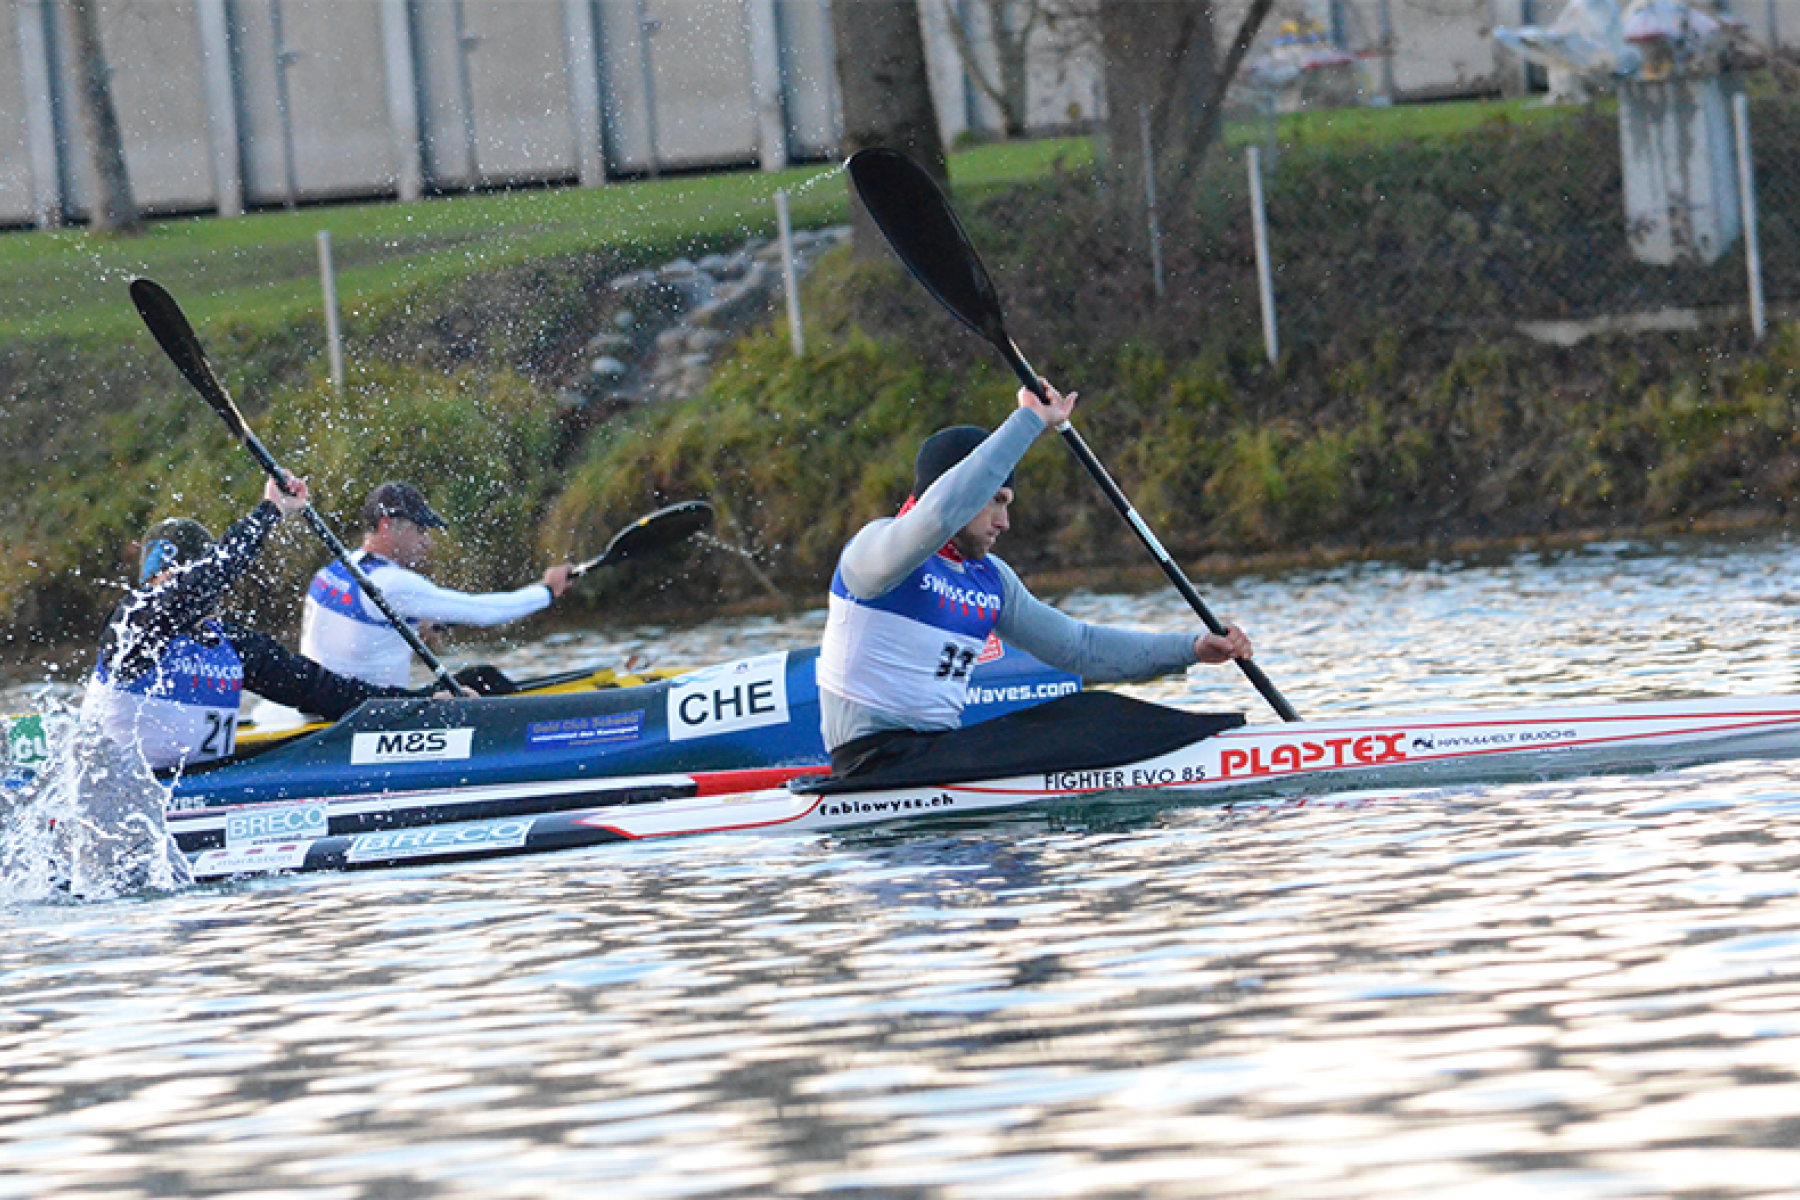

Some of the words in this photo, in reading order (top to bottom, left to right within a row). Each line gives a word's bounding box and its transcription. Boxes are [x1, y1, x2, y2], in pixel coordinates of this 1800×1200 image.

[920, 573, 1001, 611] swisscom
[169, 656, 245, 679] swissco
[678, 679, 776, 725] CHE
[200, 709, 235, 757] 21
[376, 732, 448, 755] M&S
[1220, 732, 1406, 777] PLASTEX
[1046, 771, 1125, 790] FIGHTER
[1132, 769, 1176, 785] EVO
[1182, 765, 1206, 780] 85
[229, 806, 325, 838] BRECO
[354, 824, 524, 851] BRECO
